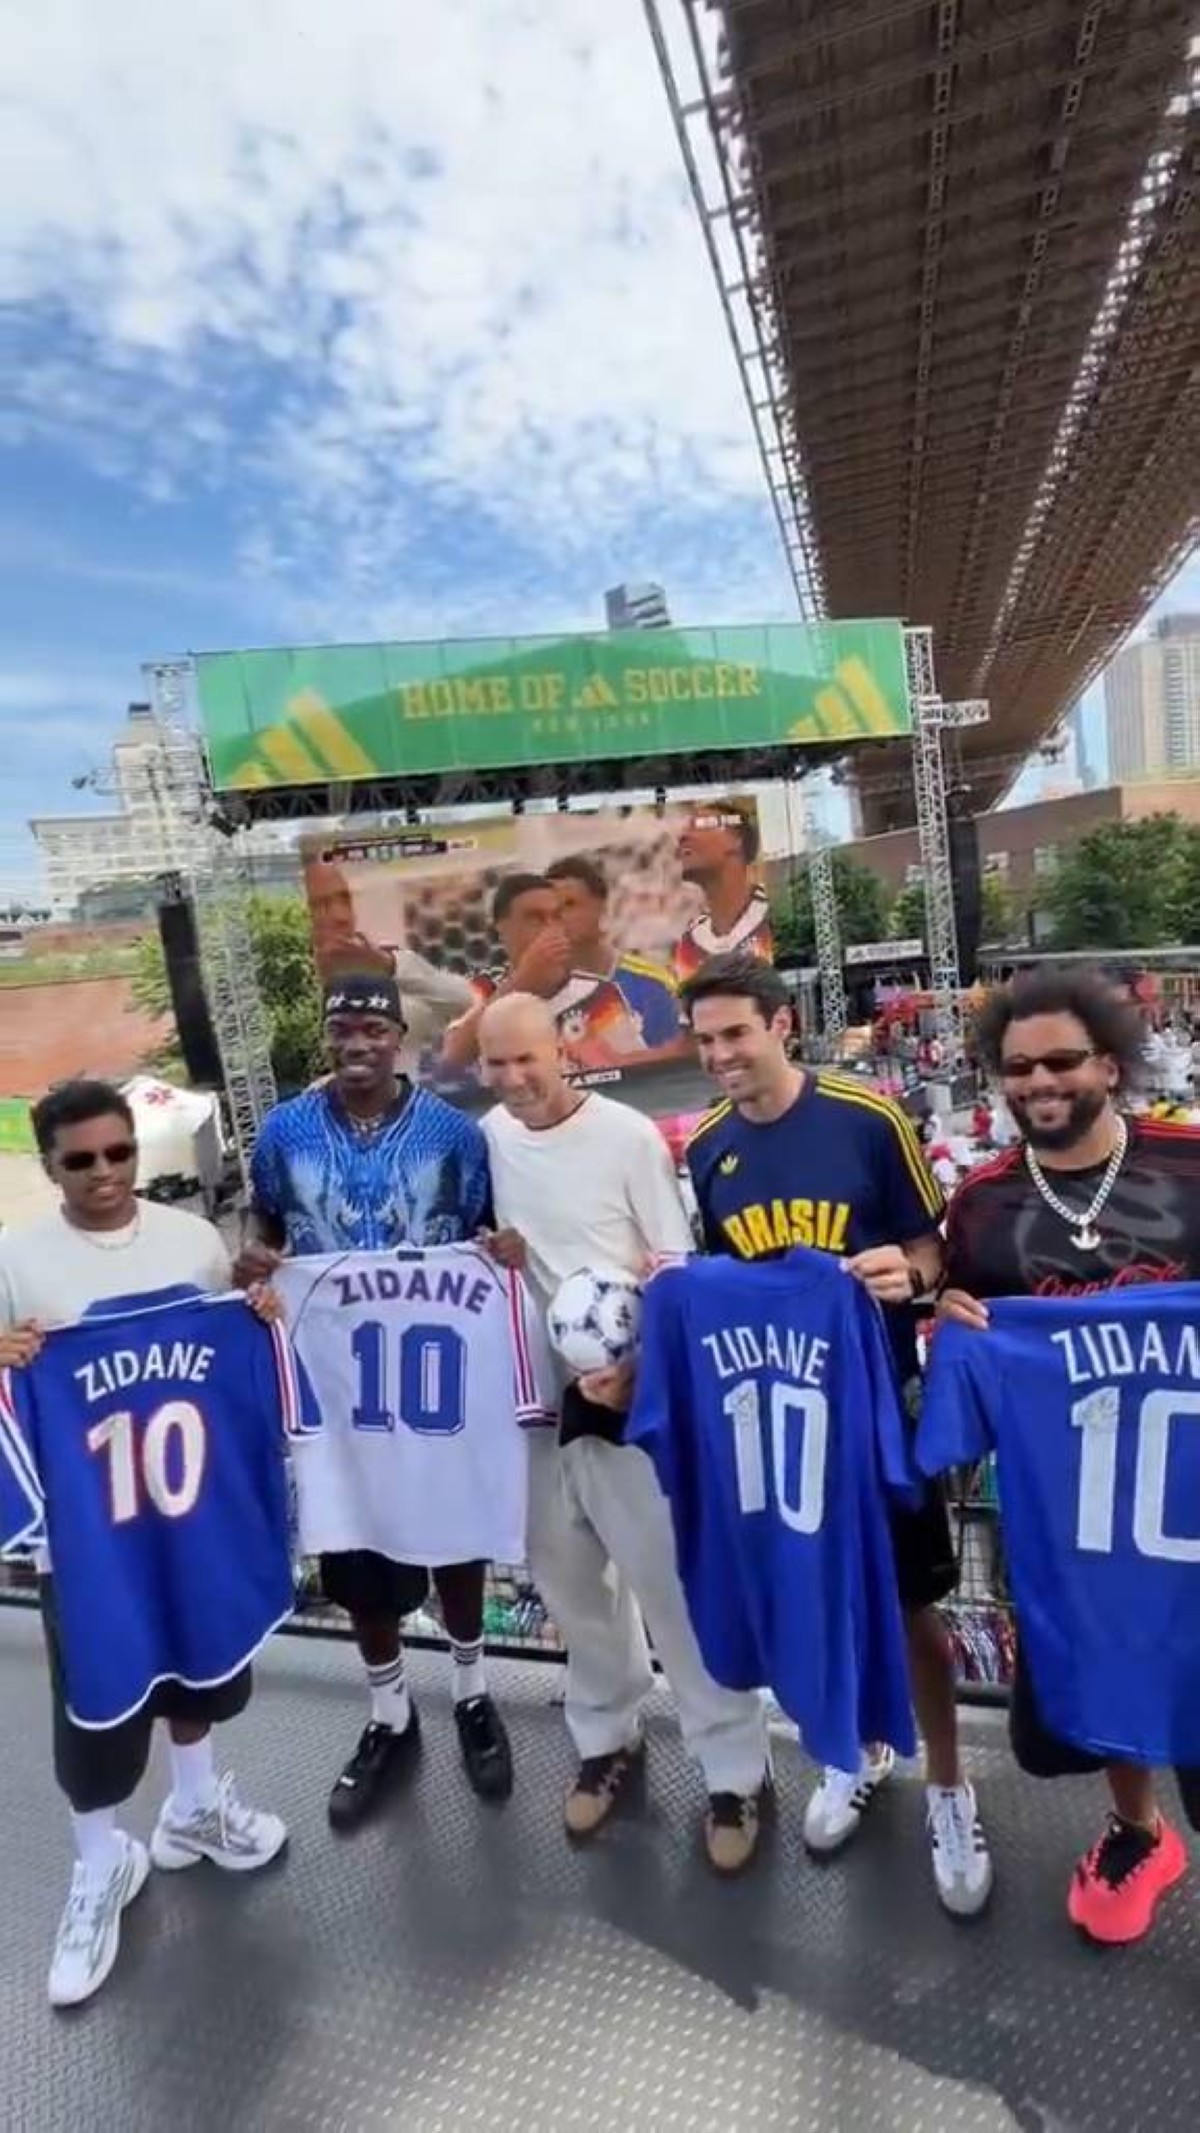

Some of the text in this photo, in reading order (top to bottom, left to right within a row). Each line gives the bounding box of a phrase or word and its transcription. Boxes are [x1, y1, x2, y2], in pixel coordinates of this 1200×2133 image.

[399, 664, 762, 719] HOME OF SOCCER
[722, 1197, 850, 1260] BRASIL
[334, 1267, 493, 1315] ZIDANE
[1031, 1260, 1187, 1298] Coca-C
[73, 1340, 216, 1403] ZIDANE
[352, 1320, 468, 1437] 10
[701, 1323, 830, 1386] ZIDANE
[86, 1399, 207, 1525] 10
[722, 1378, 829, 1535] 10
[1070, 1385, 1200, 1563] 10
